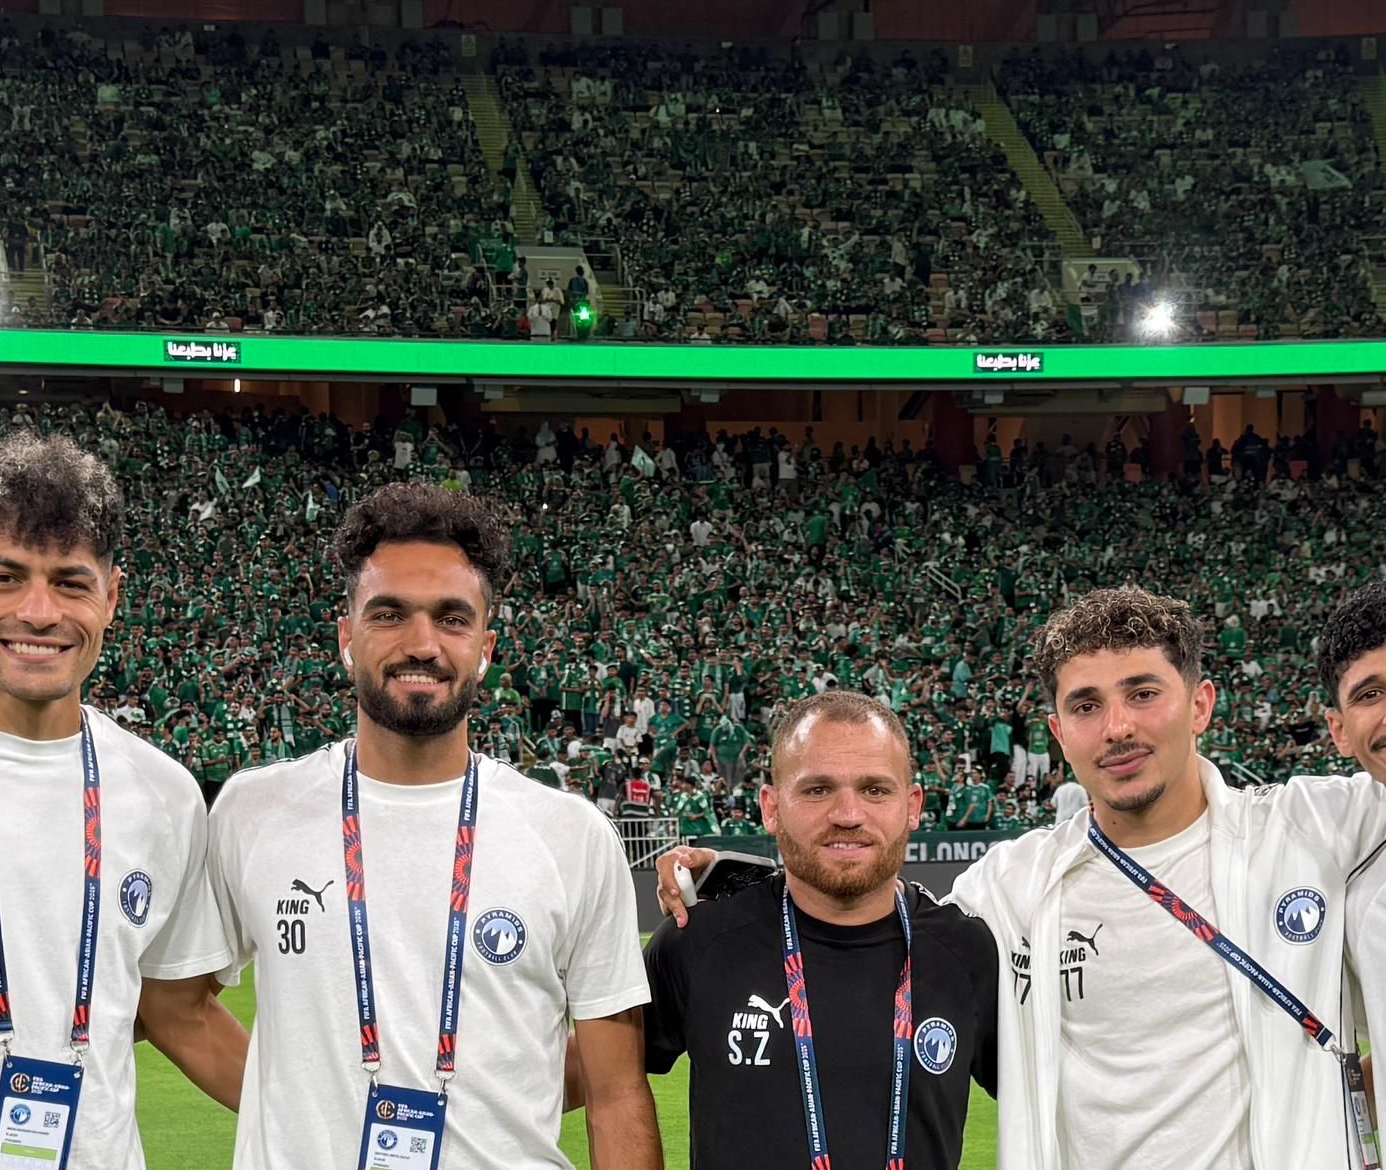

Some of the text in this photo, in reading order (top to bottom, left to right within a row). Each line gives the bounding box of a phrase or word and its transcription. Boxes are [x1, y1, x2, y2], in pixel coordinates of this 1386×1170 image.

[277, 899, 310, 915] KING
[1279, 890, 1319, 914] PYRAMIDS
[481, 911, 523, 932] PYRAMIDS
[277, 919, 305, 954] 30
[1011, 950, 1031, 970] KIN
[733, 1012, 769, 1030] KING
[728, 1030, 771, 1066] S.Z
